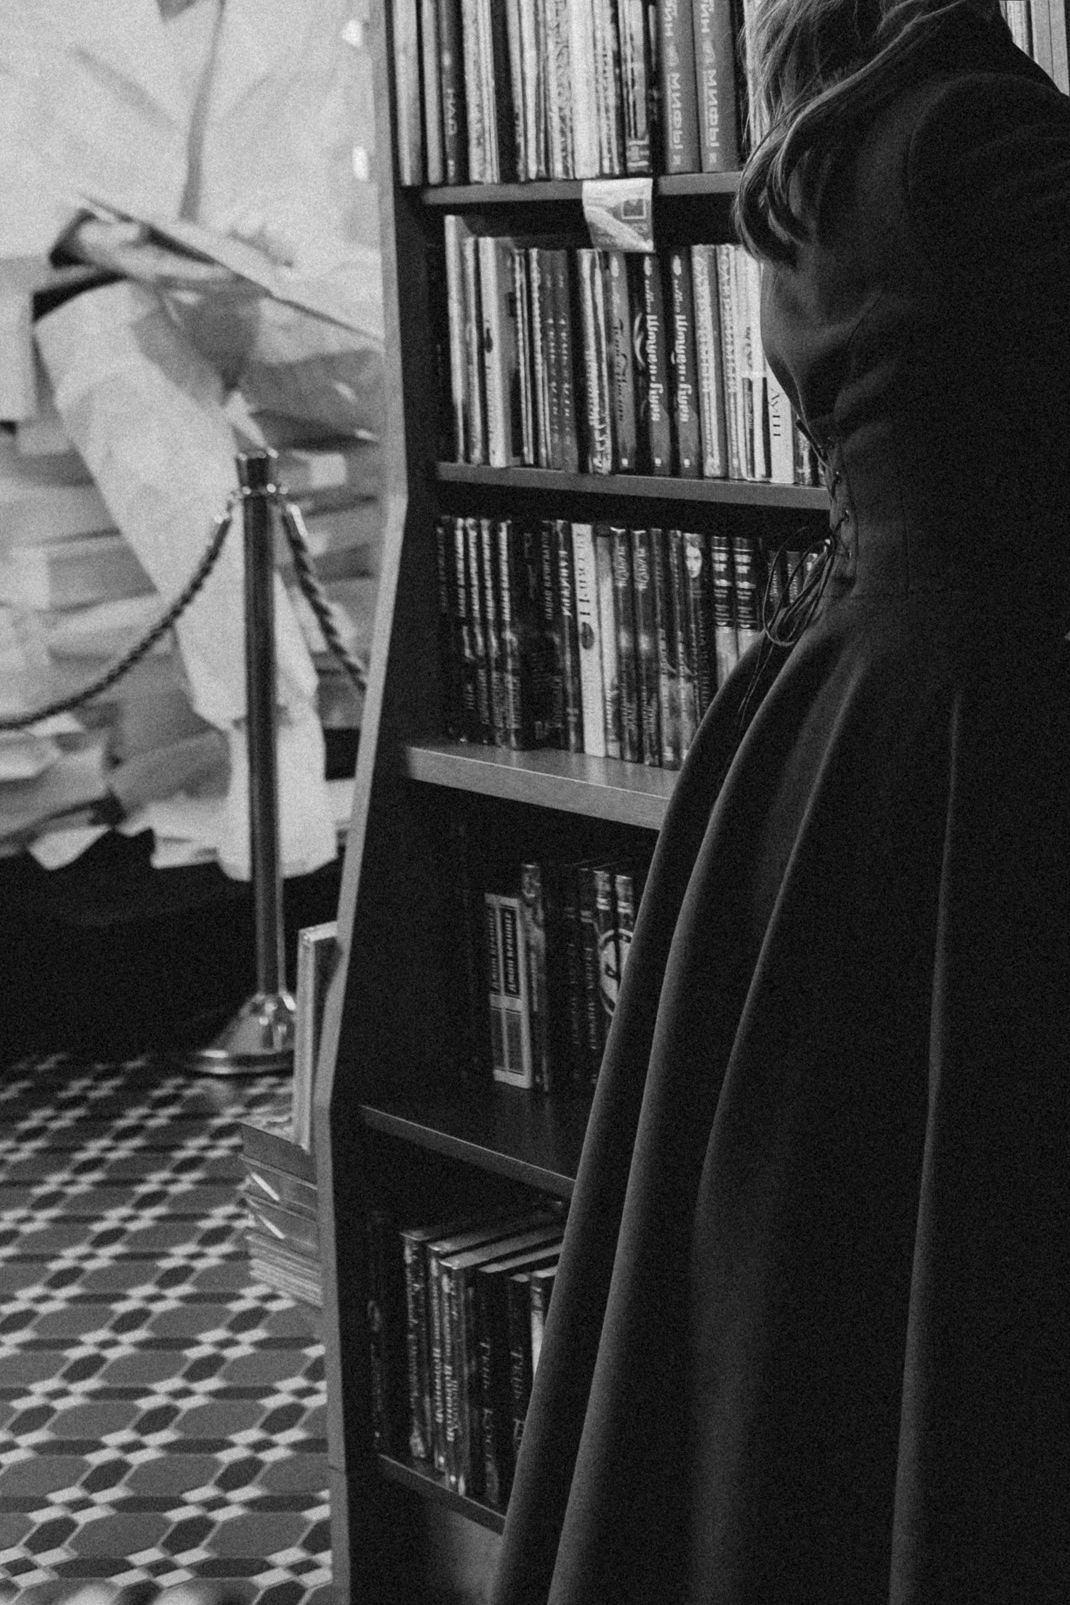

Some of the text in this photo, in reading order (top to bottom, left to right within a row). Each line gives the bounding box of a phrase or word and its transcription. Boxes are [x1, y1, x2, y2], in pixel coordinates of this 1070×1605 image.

[670, 73, 683, 150] МИФЫ
[707, 70, 720, 148] МИФЫ
[505, 959, 517, 993] ДЖОН
